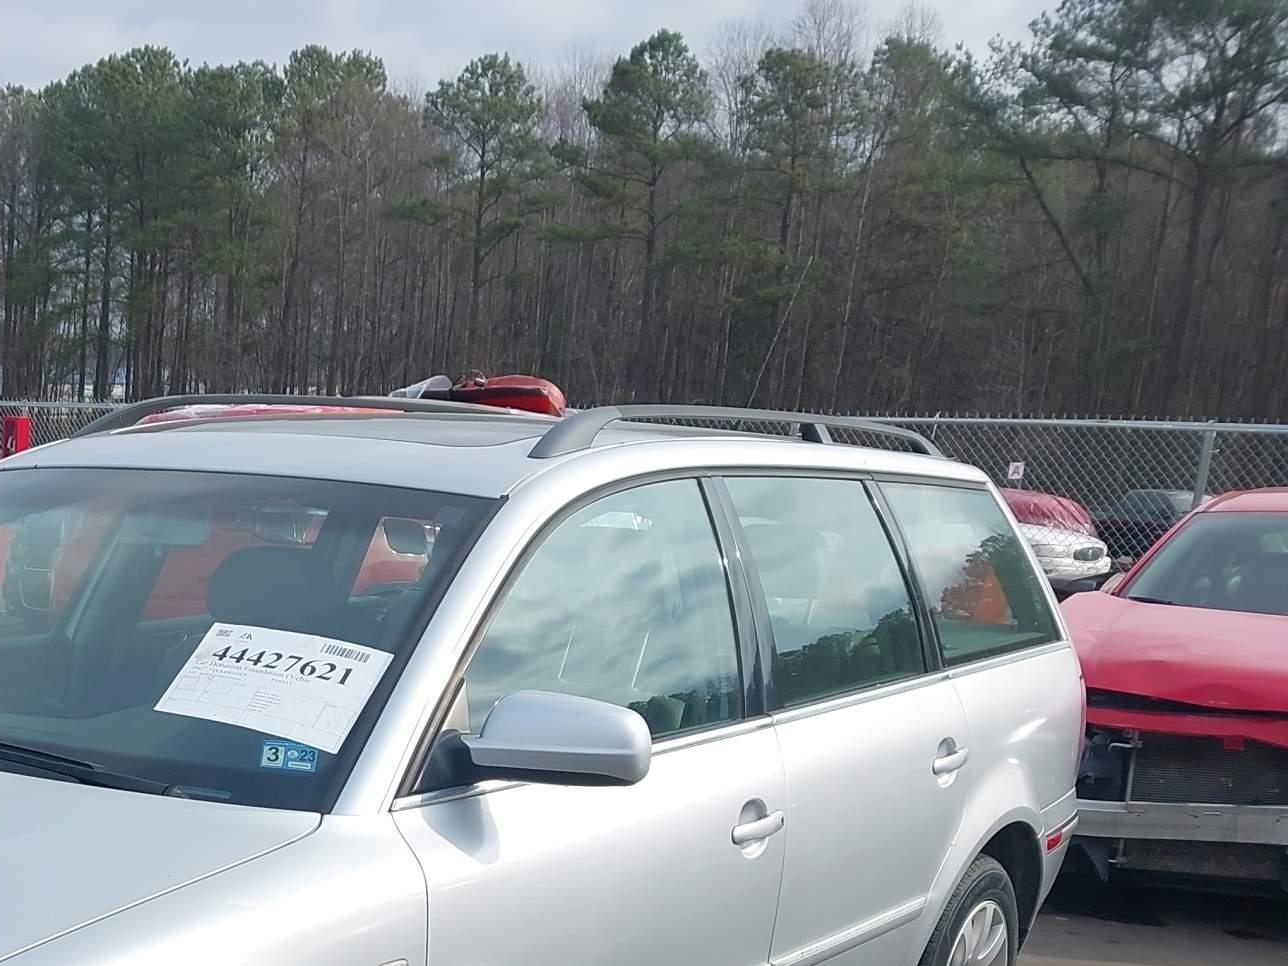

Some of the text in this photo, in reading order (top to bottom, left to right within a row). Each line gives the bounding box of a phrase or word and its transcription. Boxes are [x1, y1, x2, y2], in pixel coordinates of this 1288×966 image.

[212, 645, 354, 686] 44427621
[266, 746, 316, 762] 3 23
